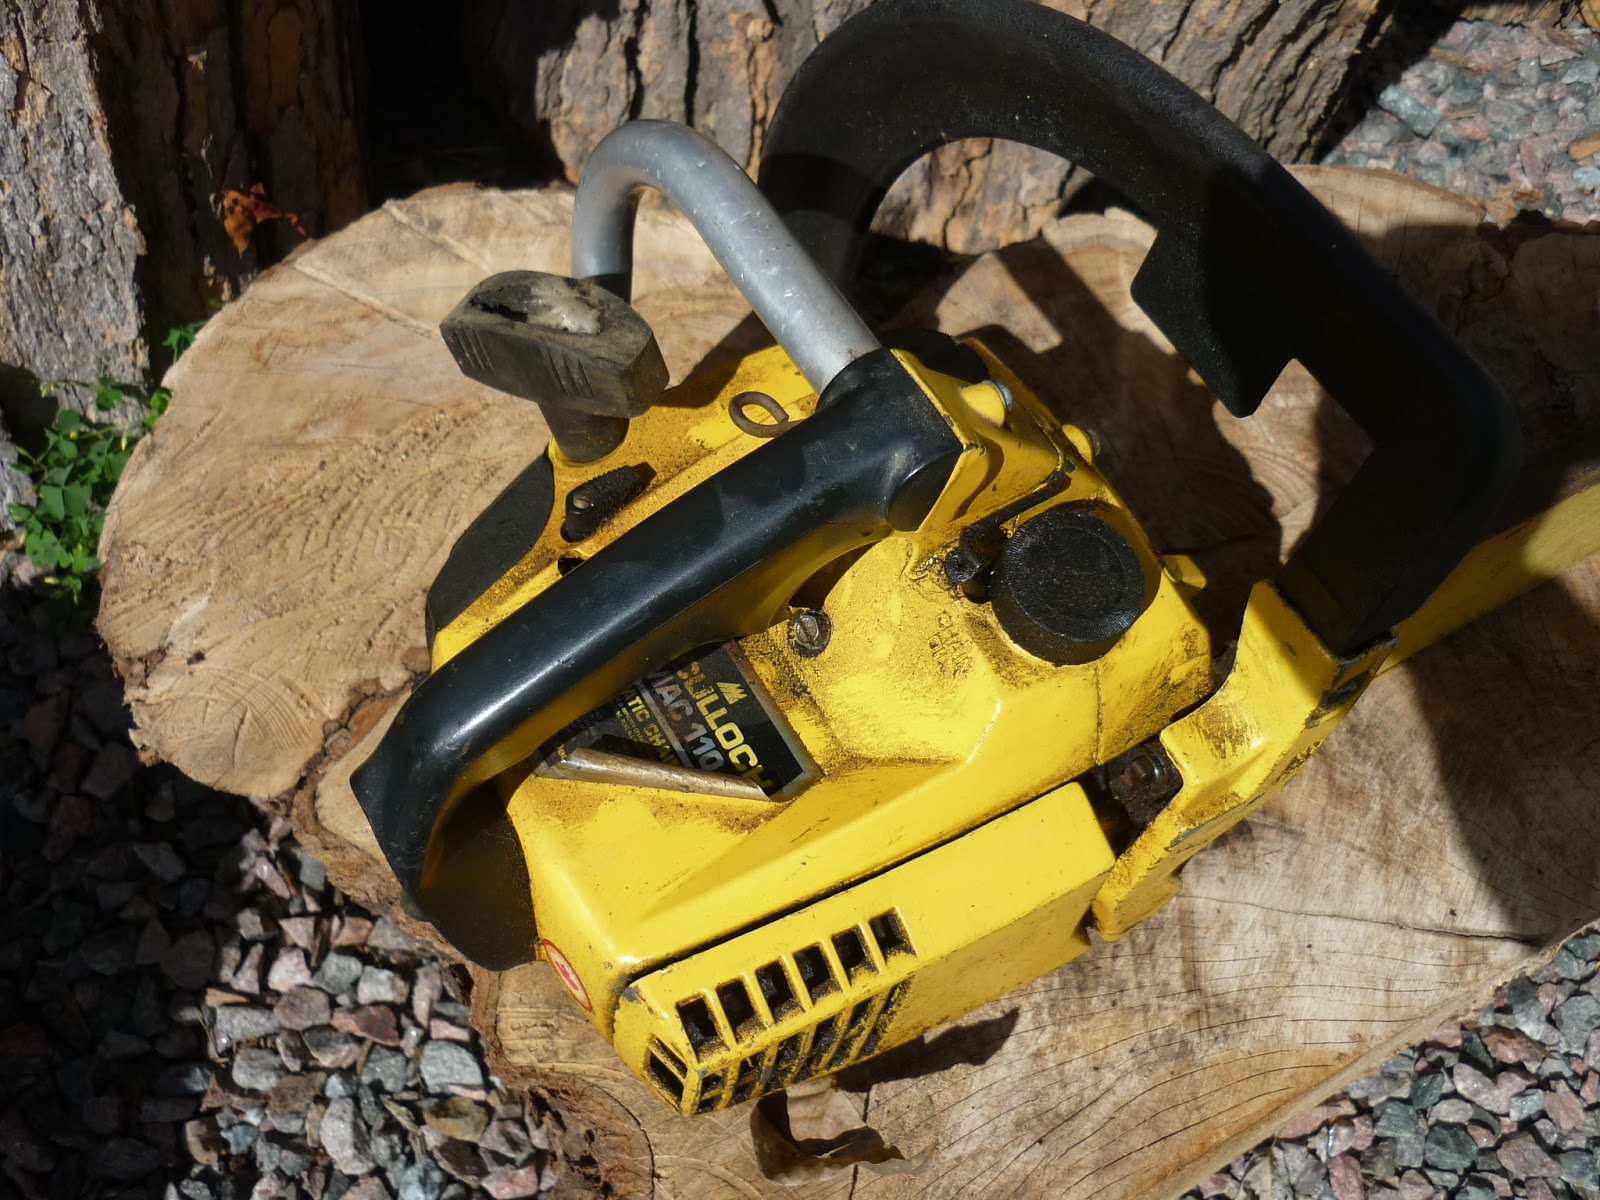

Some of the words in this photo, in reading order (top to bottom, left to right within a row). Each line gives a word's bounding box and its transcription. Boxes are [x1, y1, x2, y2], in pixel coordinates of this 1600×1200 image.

[622, 688, 651, 722] ATIC
[675, 659, 773, 788] CULLOCH
[684, 722, 724, 771] 110
